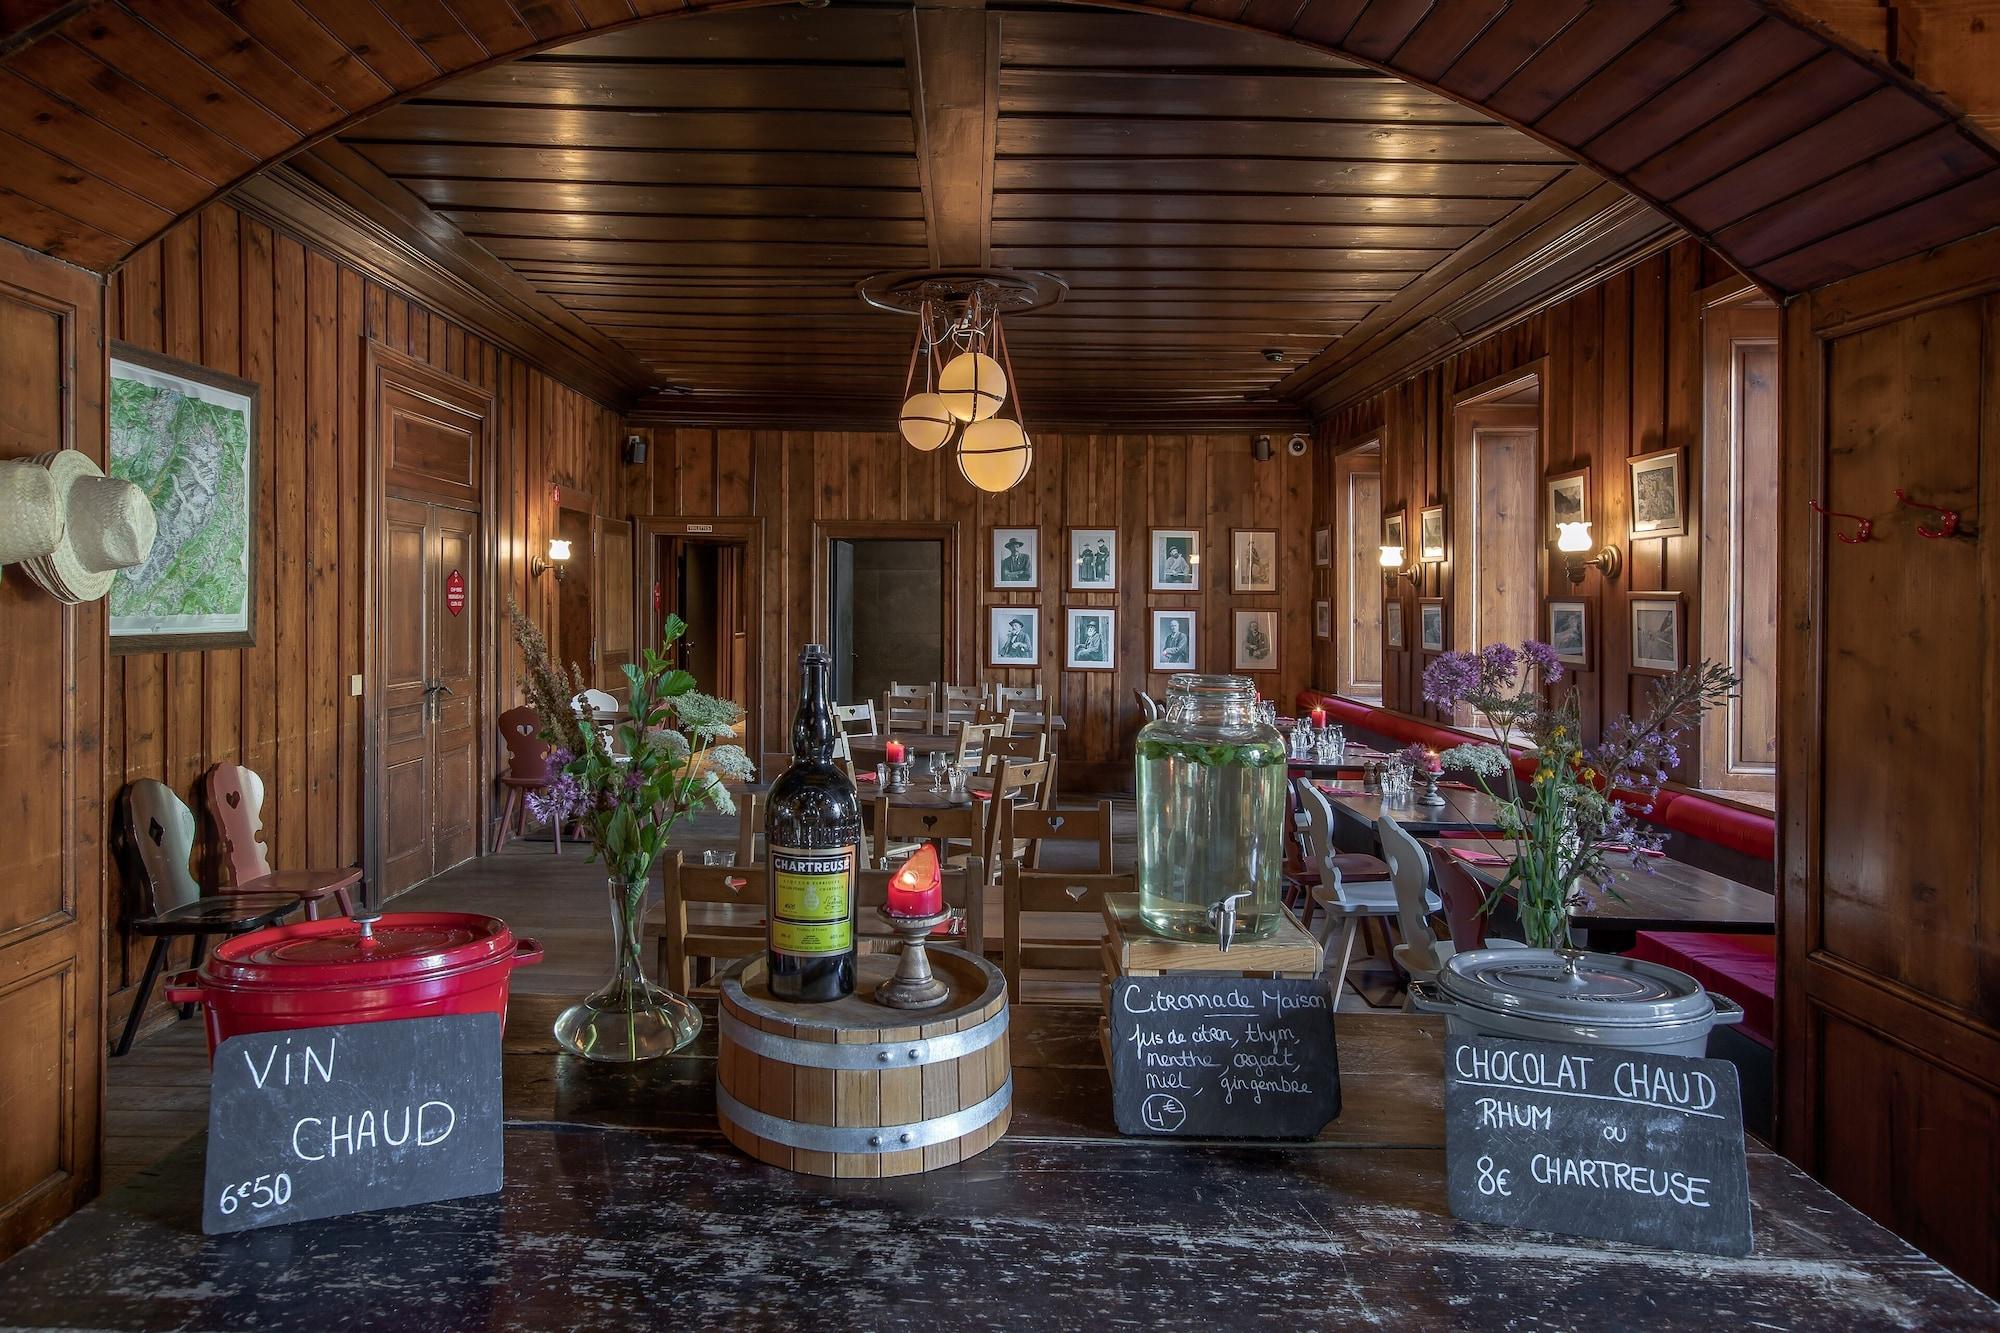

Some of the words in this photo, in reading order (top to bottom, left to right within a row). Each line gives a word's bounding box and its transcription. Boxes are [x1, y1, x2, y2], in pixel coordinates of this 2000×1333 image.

[775, 857, 850, 873] CHARTREUSE
[1262, 989, 1328, 1019] Maison
[1167, 1029, 1187, 1044] de
[1244, 1023, 1301, 1055] thym,
[1455, 1045, 1594, 1090] CHOCOLAT
[1613, 1062, 1717, 1110] CHAUD
[292, 1101, 456, 1161] CHAUD
[1474, 1097, 1552, 1131] RHUM
[219, 1173, 293, 1215] 6€50
[1475, 1155, 1512, 1197] 8€
[1530, 1153, 1711, 1208] CHARTREUSE
